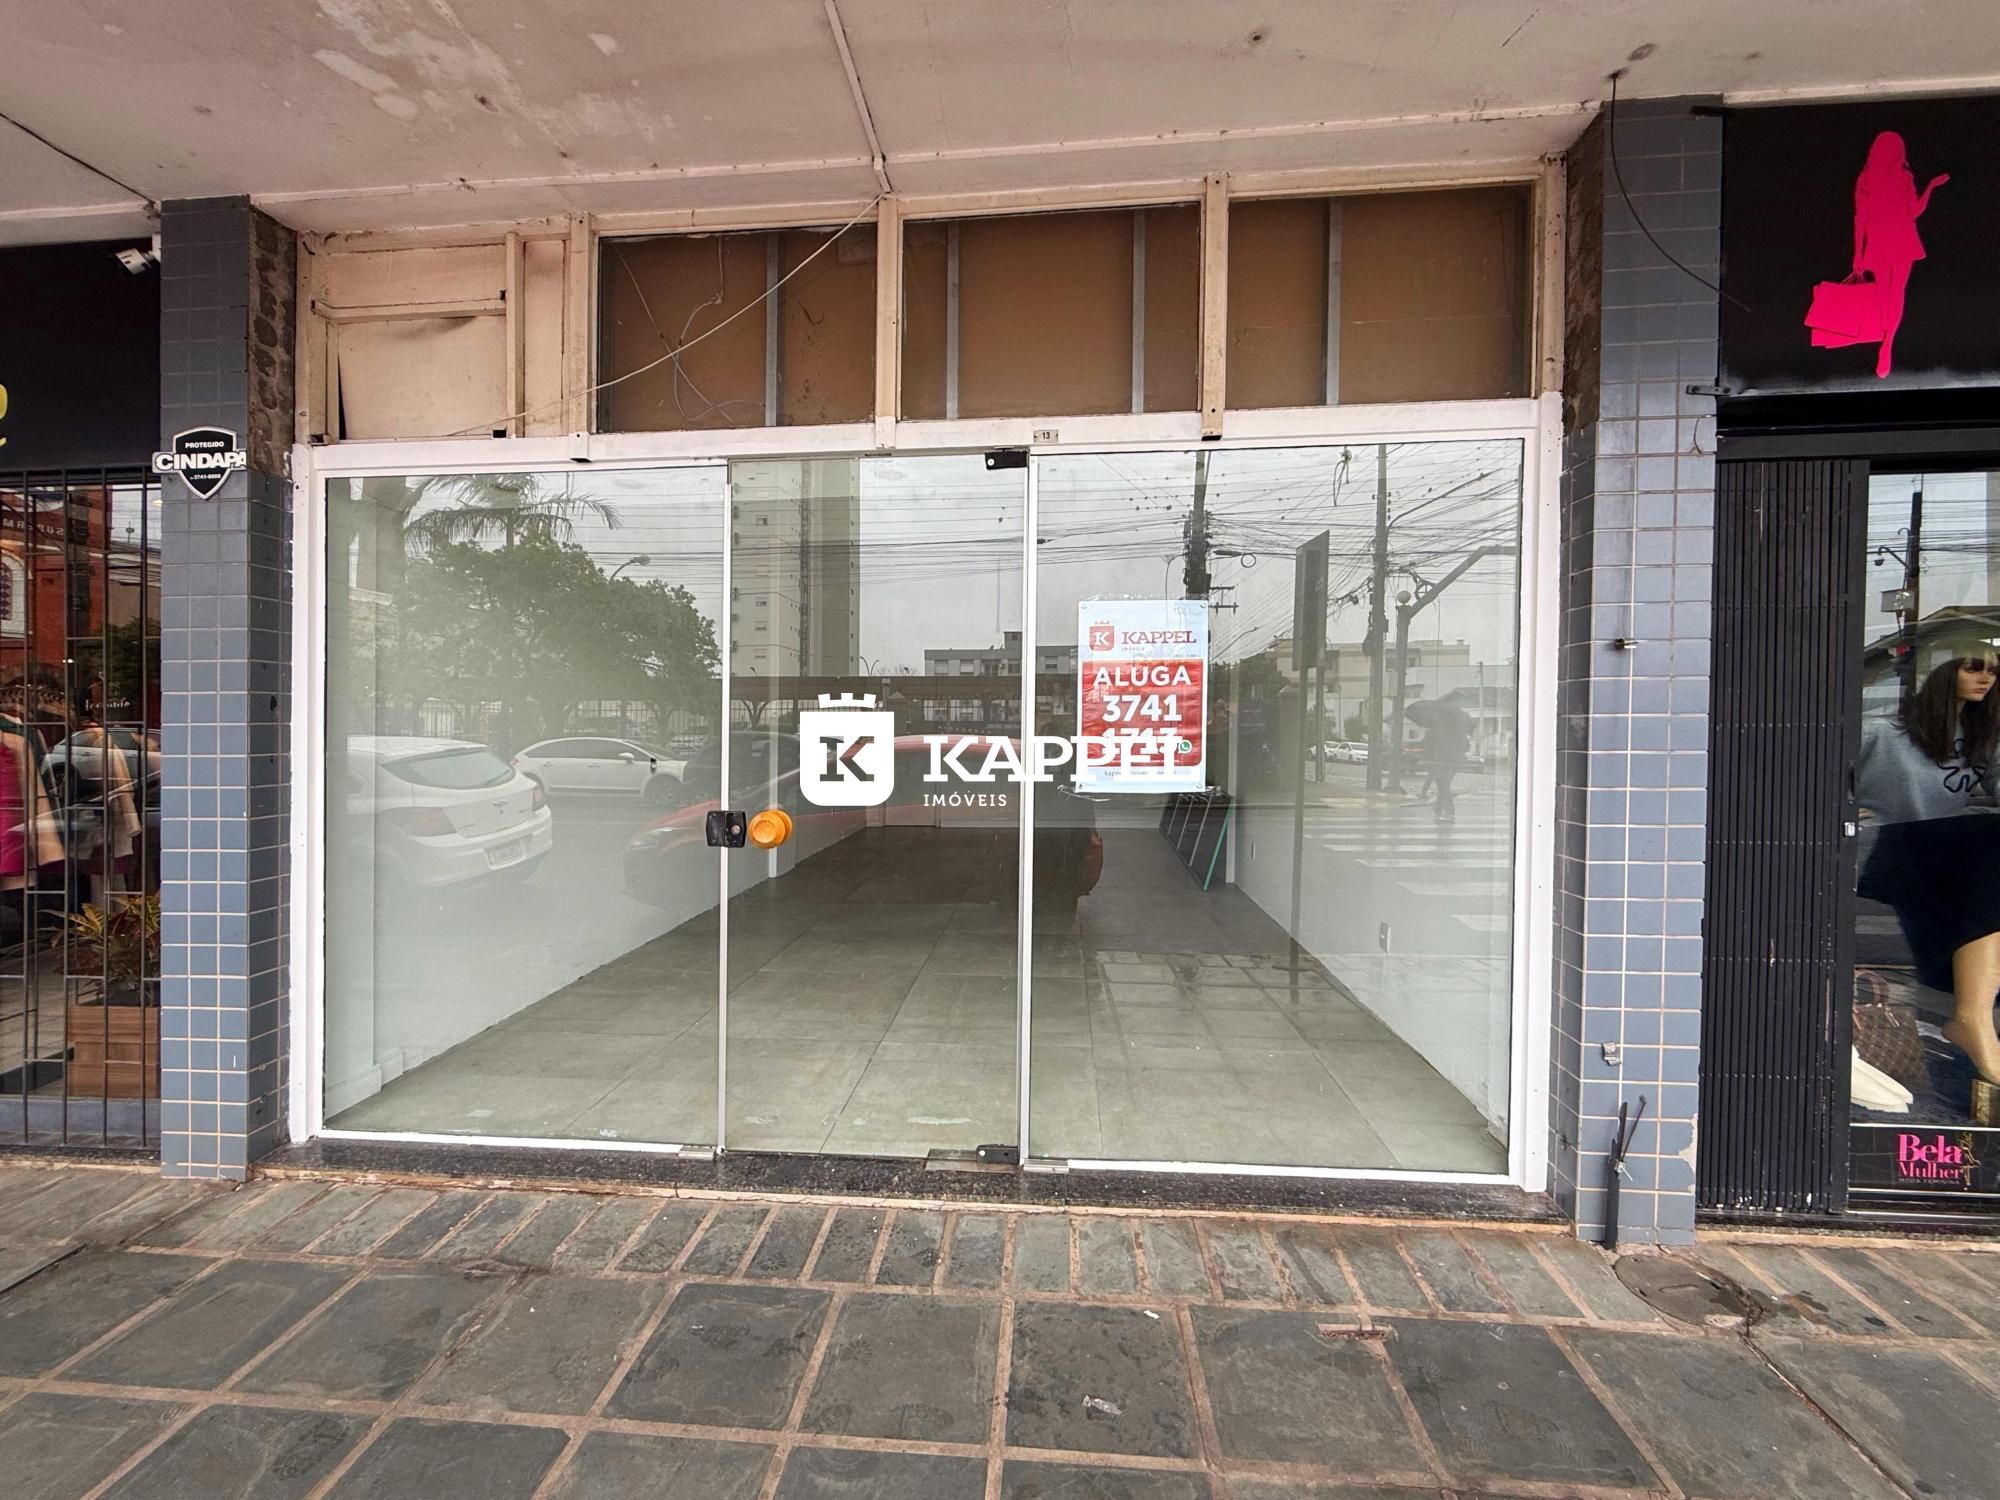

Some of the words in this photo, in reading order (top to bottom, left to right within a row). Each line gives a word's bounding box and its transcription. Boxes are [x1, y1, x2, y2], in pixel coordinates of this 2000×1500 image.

[184, 440, 225, 449] PROTEGIDO
[1042, 431, 1051, 440] 13
[155, 451, 247, 470] CINDAPA
[1121, 630, 1197, 645] KAPPEL
[1093, 665, 1192, 687] ALUGA
[1102, 694, 1181, 722] 3741
[1896, 1134, 1962, 1163] Bela
[1898, 1161, 1963, 1179] Mulher
